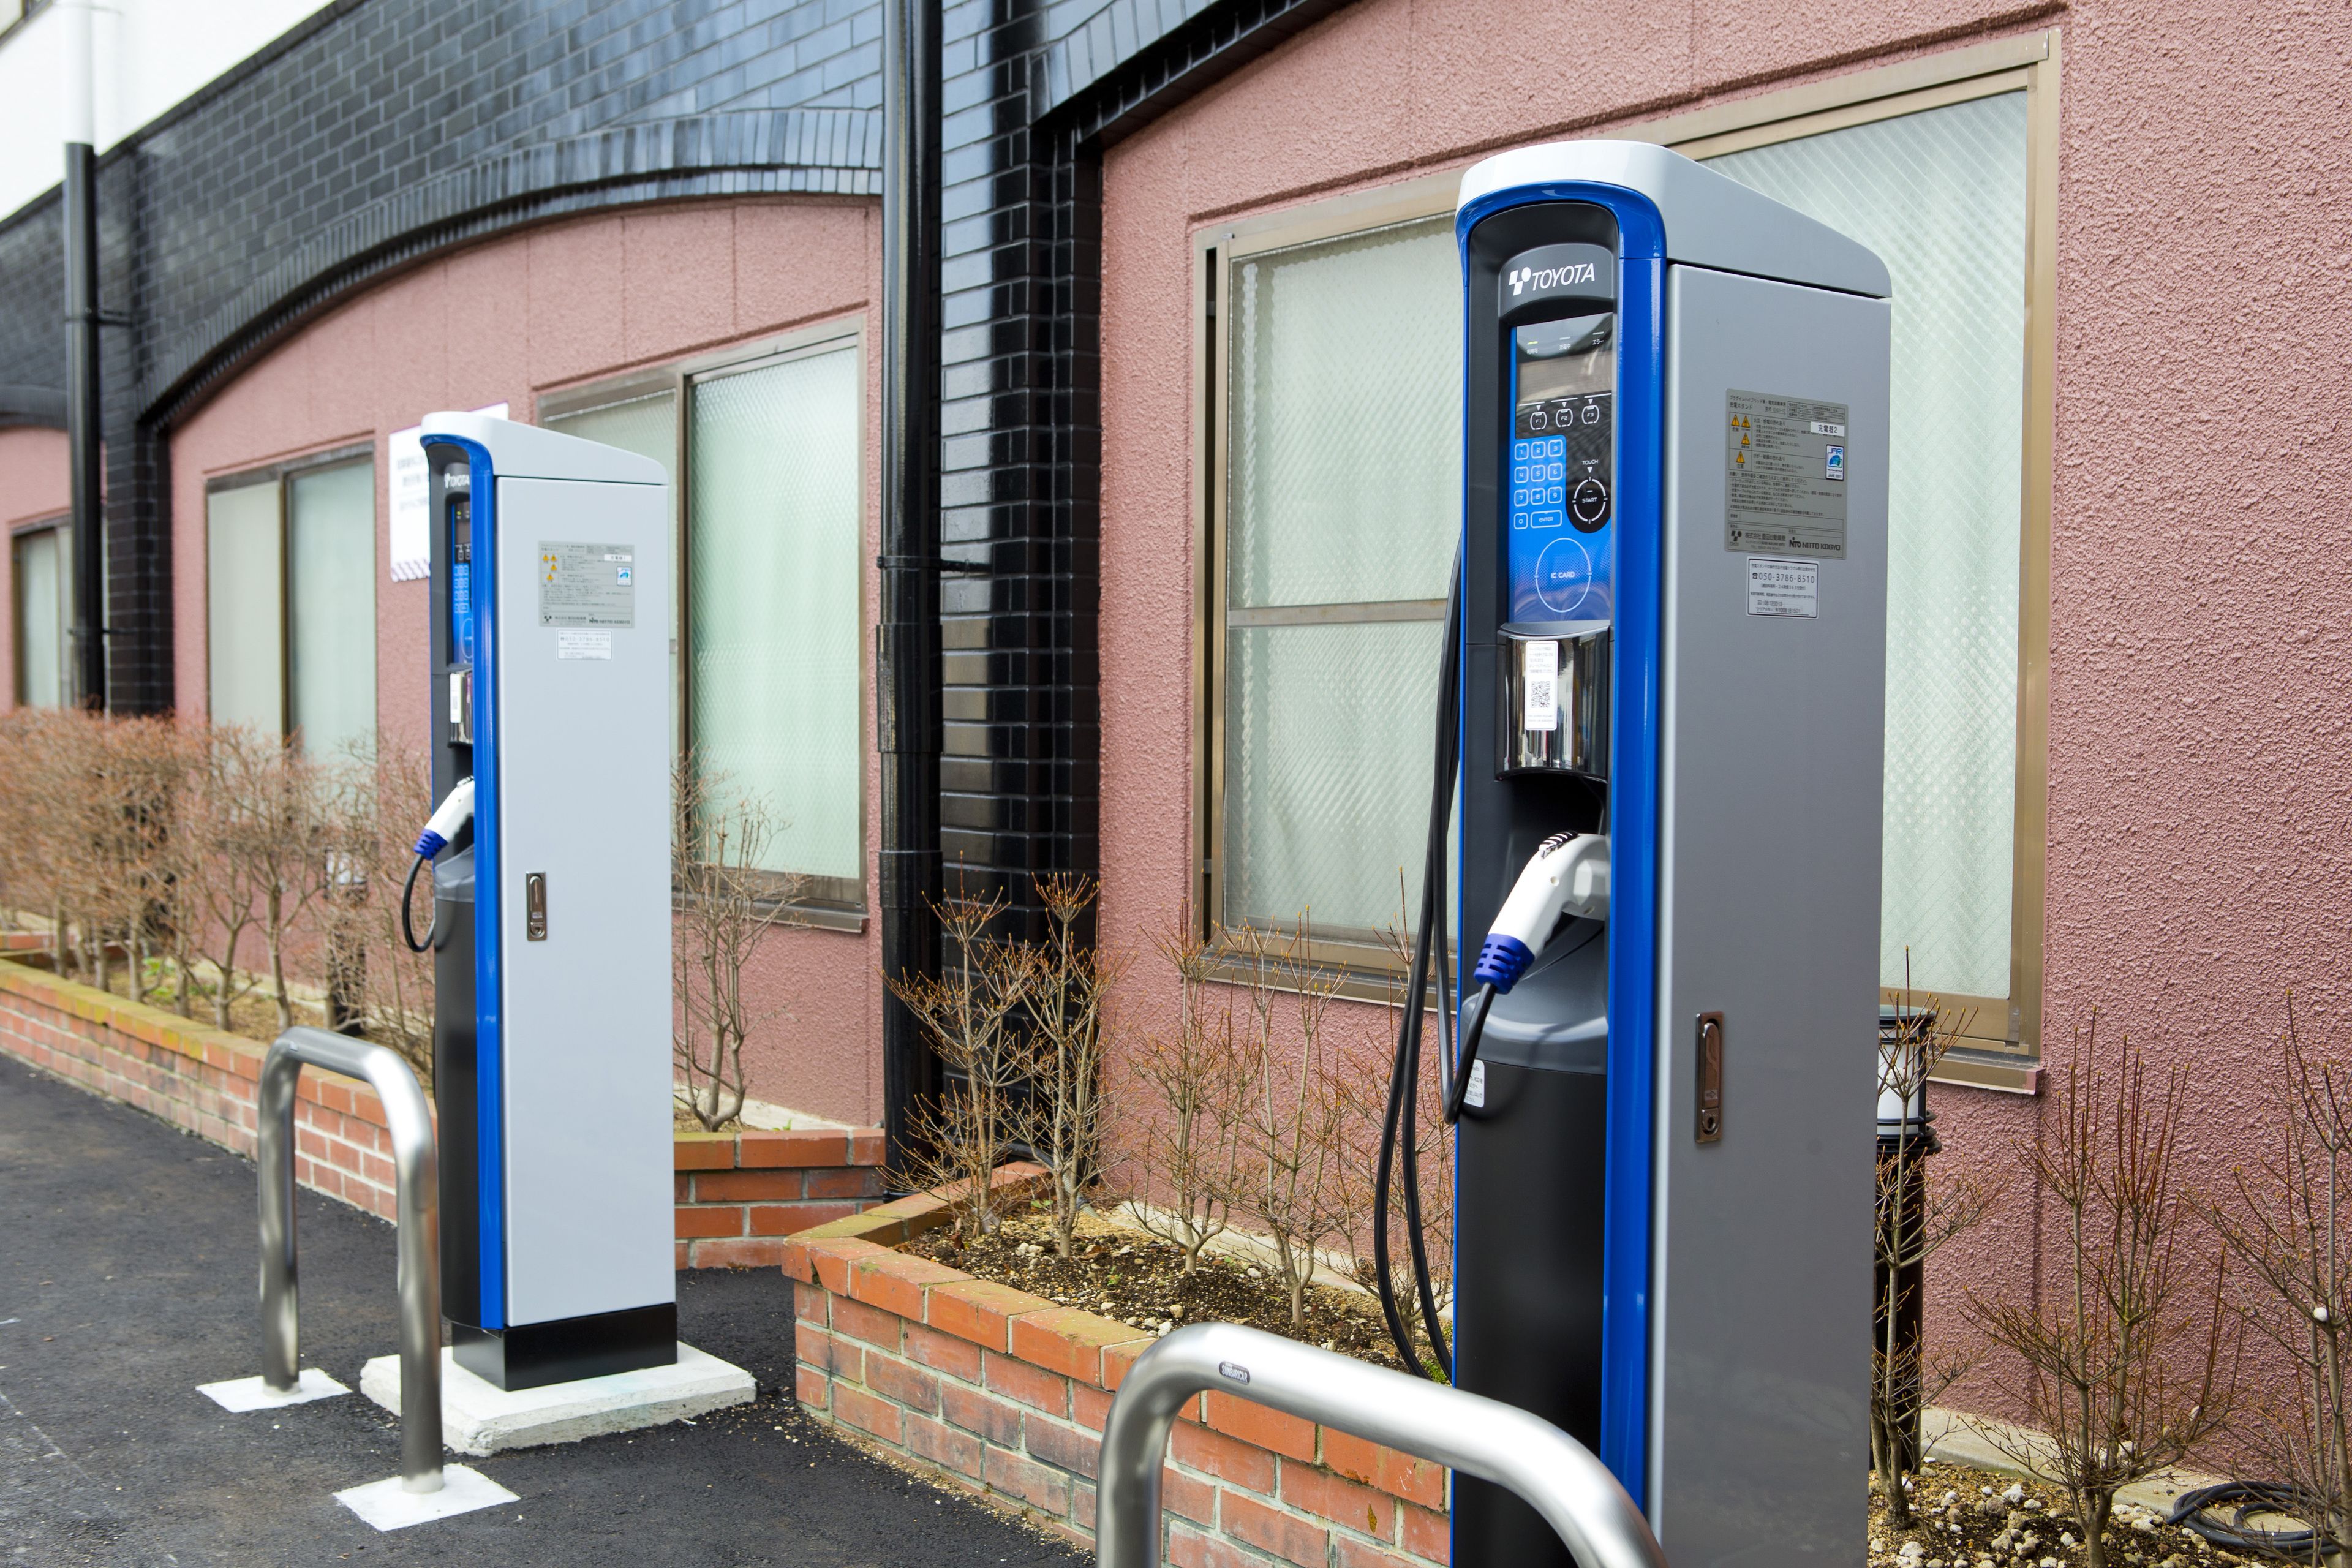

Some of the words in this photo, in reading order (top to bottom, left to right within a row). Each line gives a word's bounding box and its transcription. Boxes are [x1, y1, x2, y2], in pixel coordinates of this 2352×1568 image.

[1532, 263, 1595, 291] TOYOTA
[1818, 424, 1838, 434] 充電器2
[1758, 572, 1815, 584] 050-3786-8510
